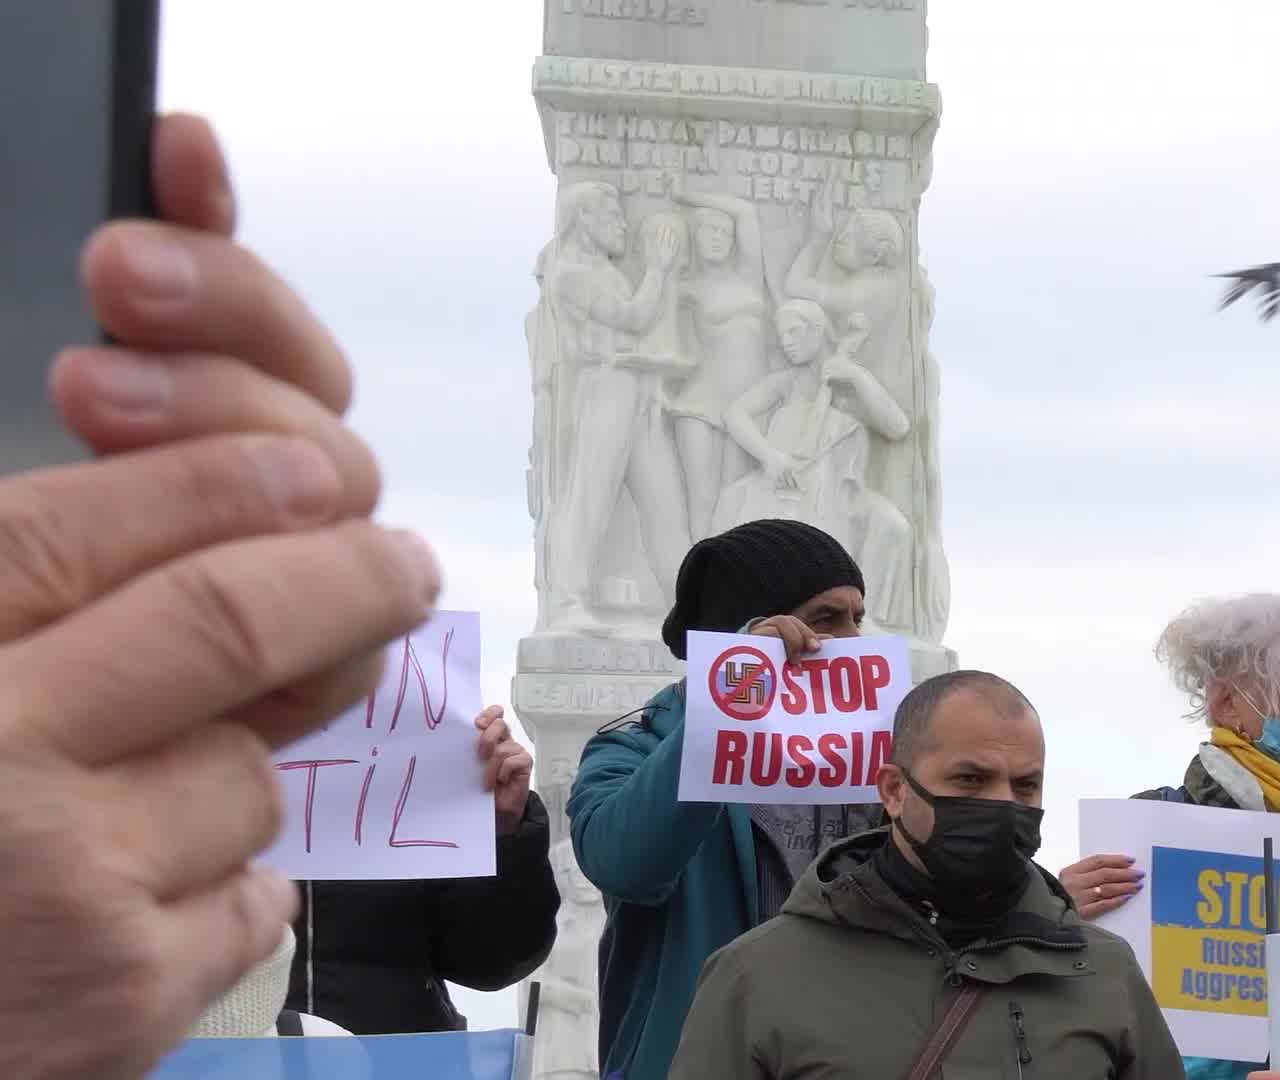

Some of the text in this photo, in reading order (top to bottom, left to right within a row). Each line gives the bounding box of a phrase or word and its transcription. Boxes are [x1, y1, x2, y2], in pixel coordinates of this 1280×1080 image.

[780, 655, 891, 715] STOP
[712, 730, 893, 788] RUSSIA
[273, 746, 460, 853] TİL
[1180, 969, 1267, 1001] Aggres
